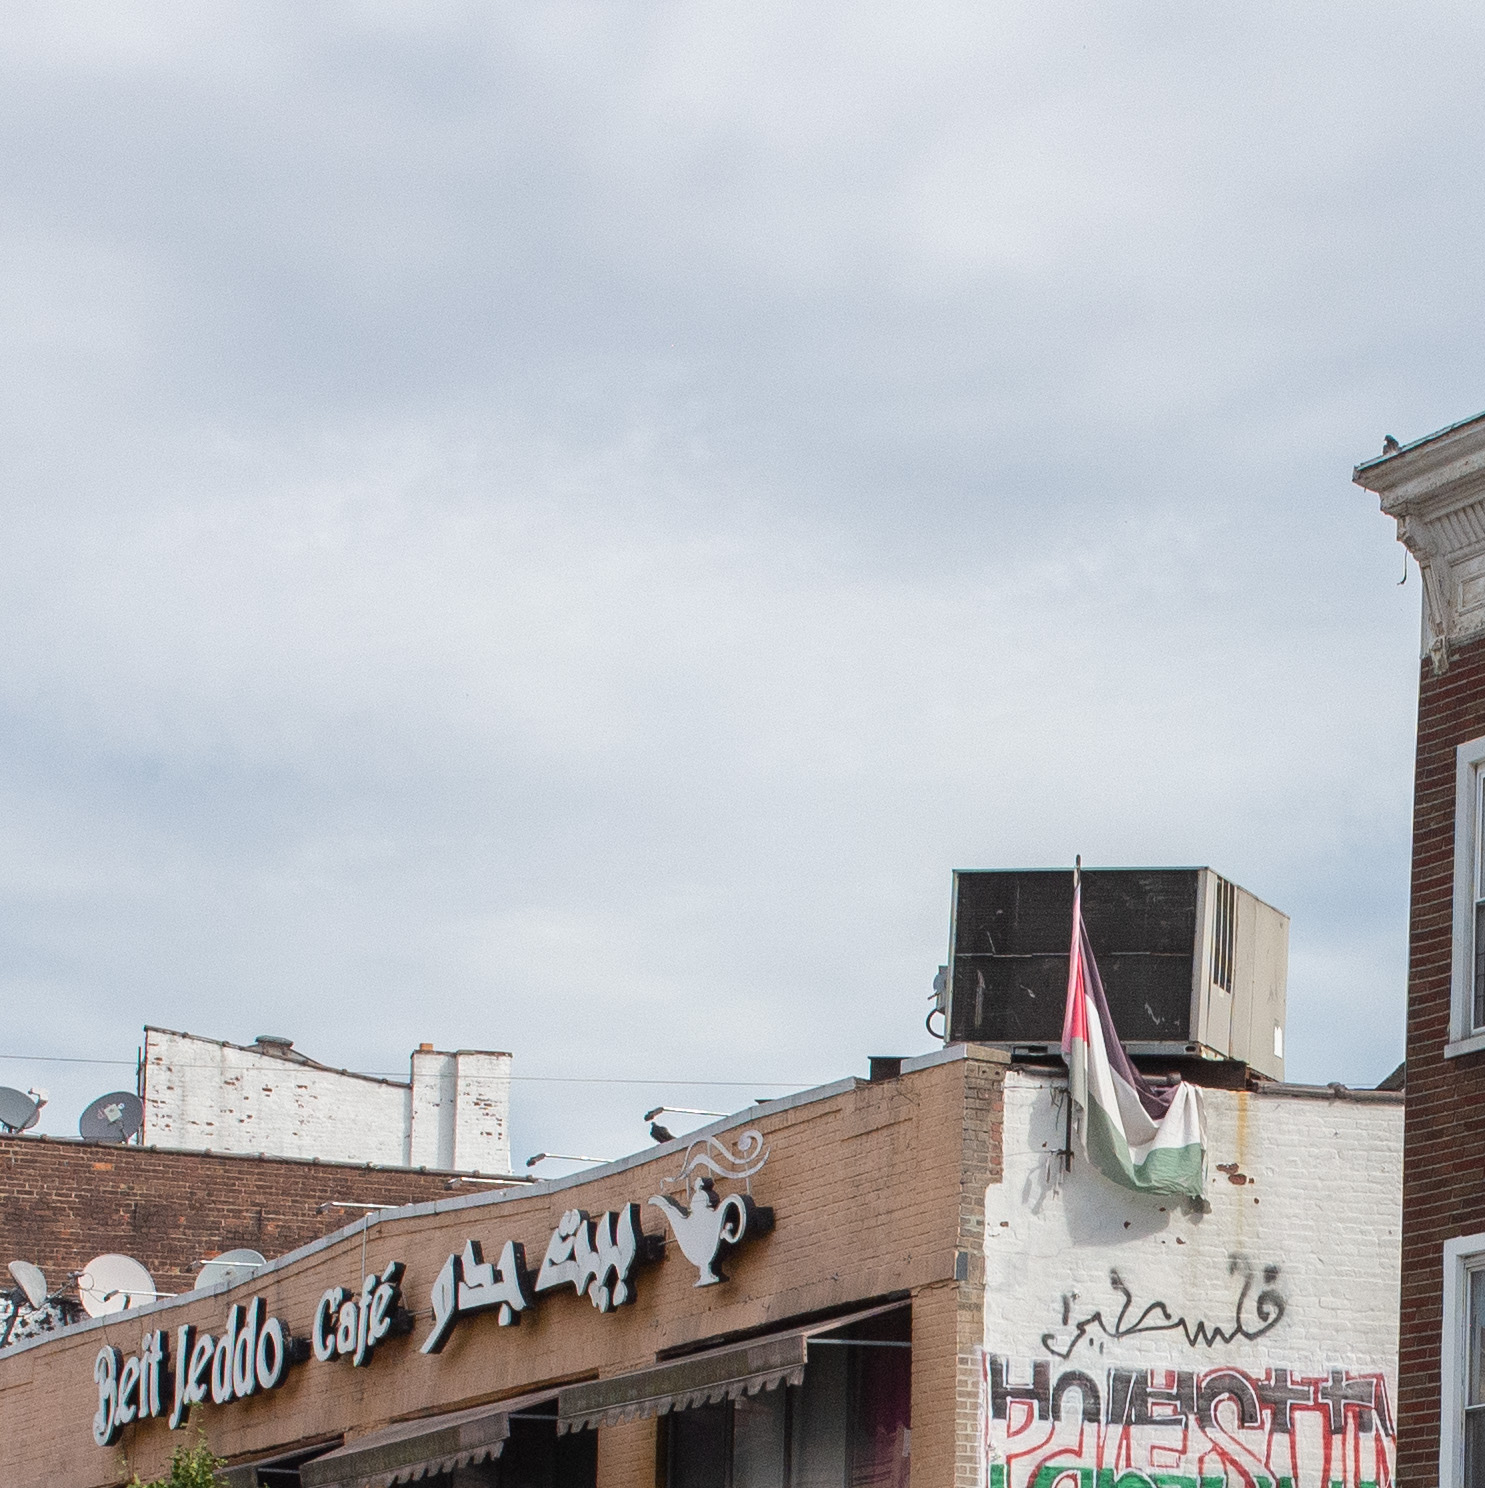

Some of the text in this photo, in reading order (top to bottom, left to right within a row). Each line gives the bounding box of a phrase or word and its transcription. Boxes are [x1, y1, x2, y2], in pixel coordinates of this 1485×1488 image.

[94, 1262, 404, 1446] Beit Jeddo Café
